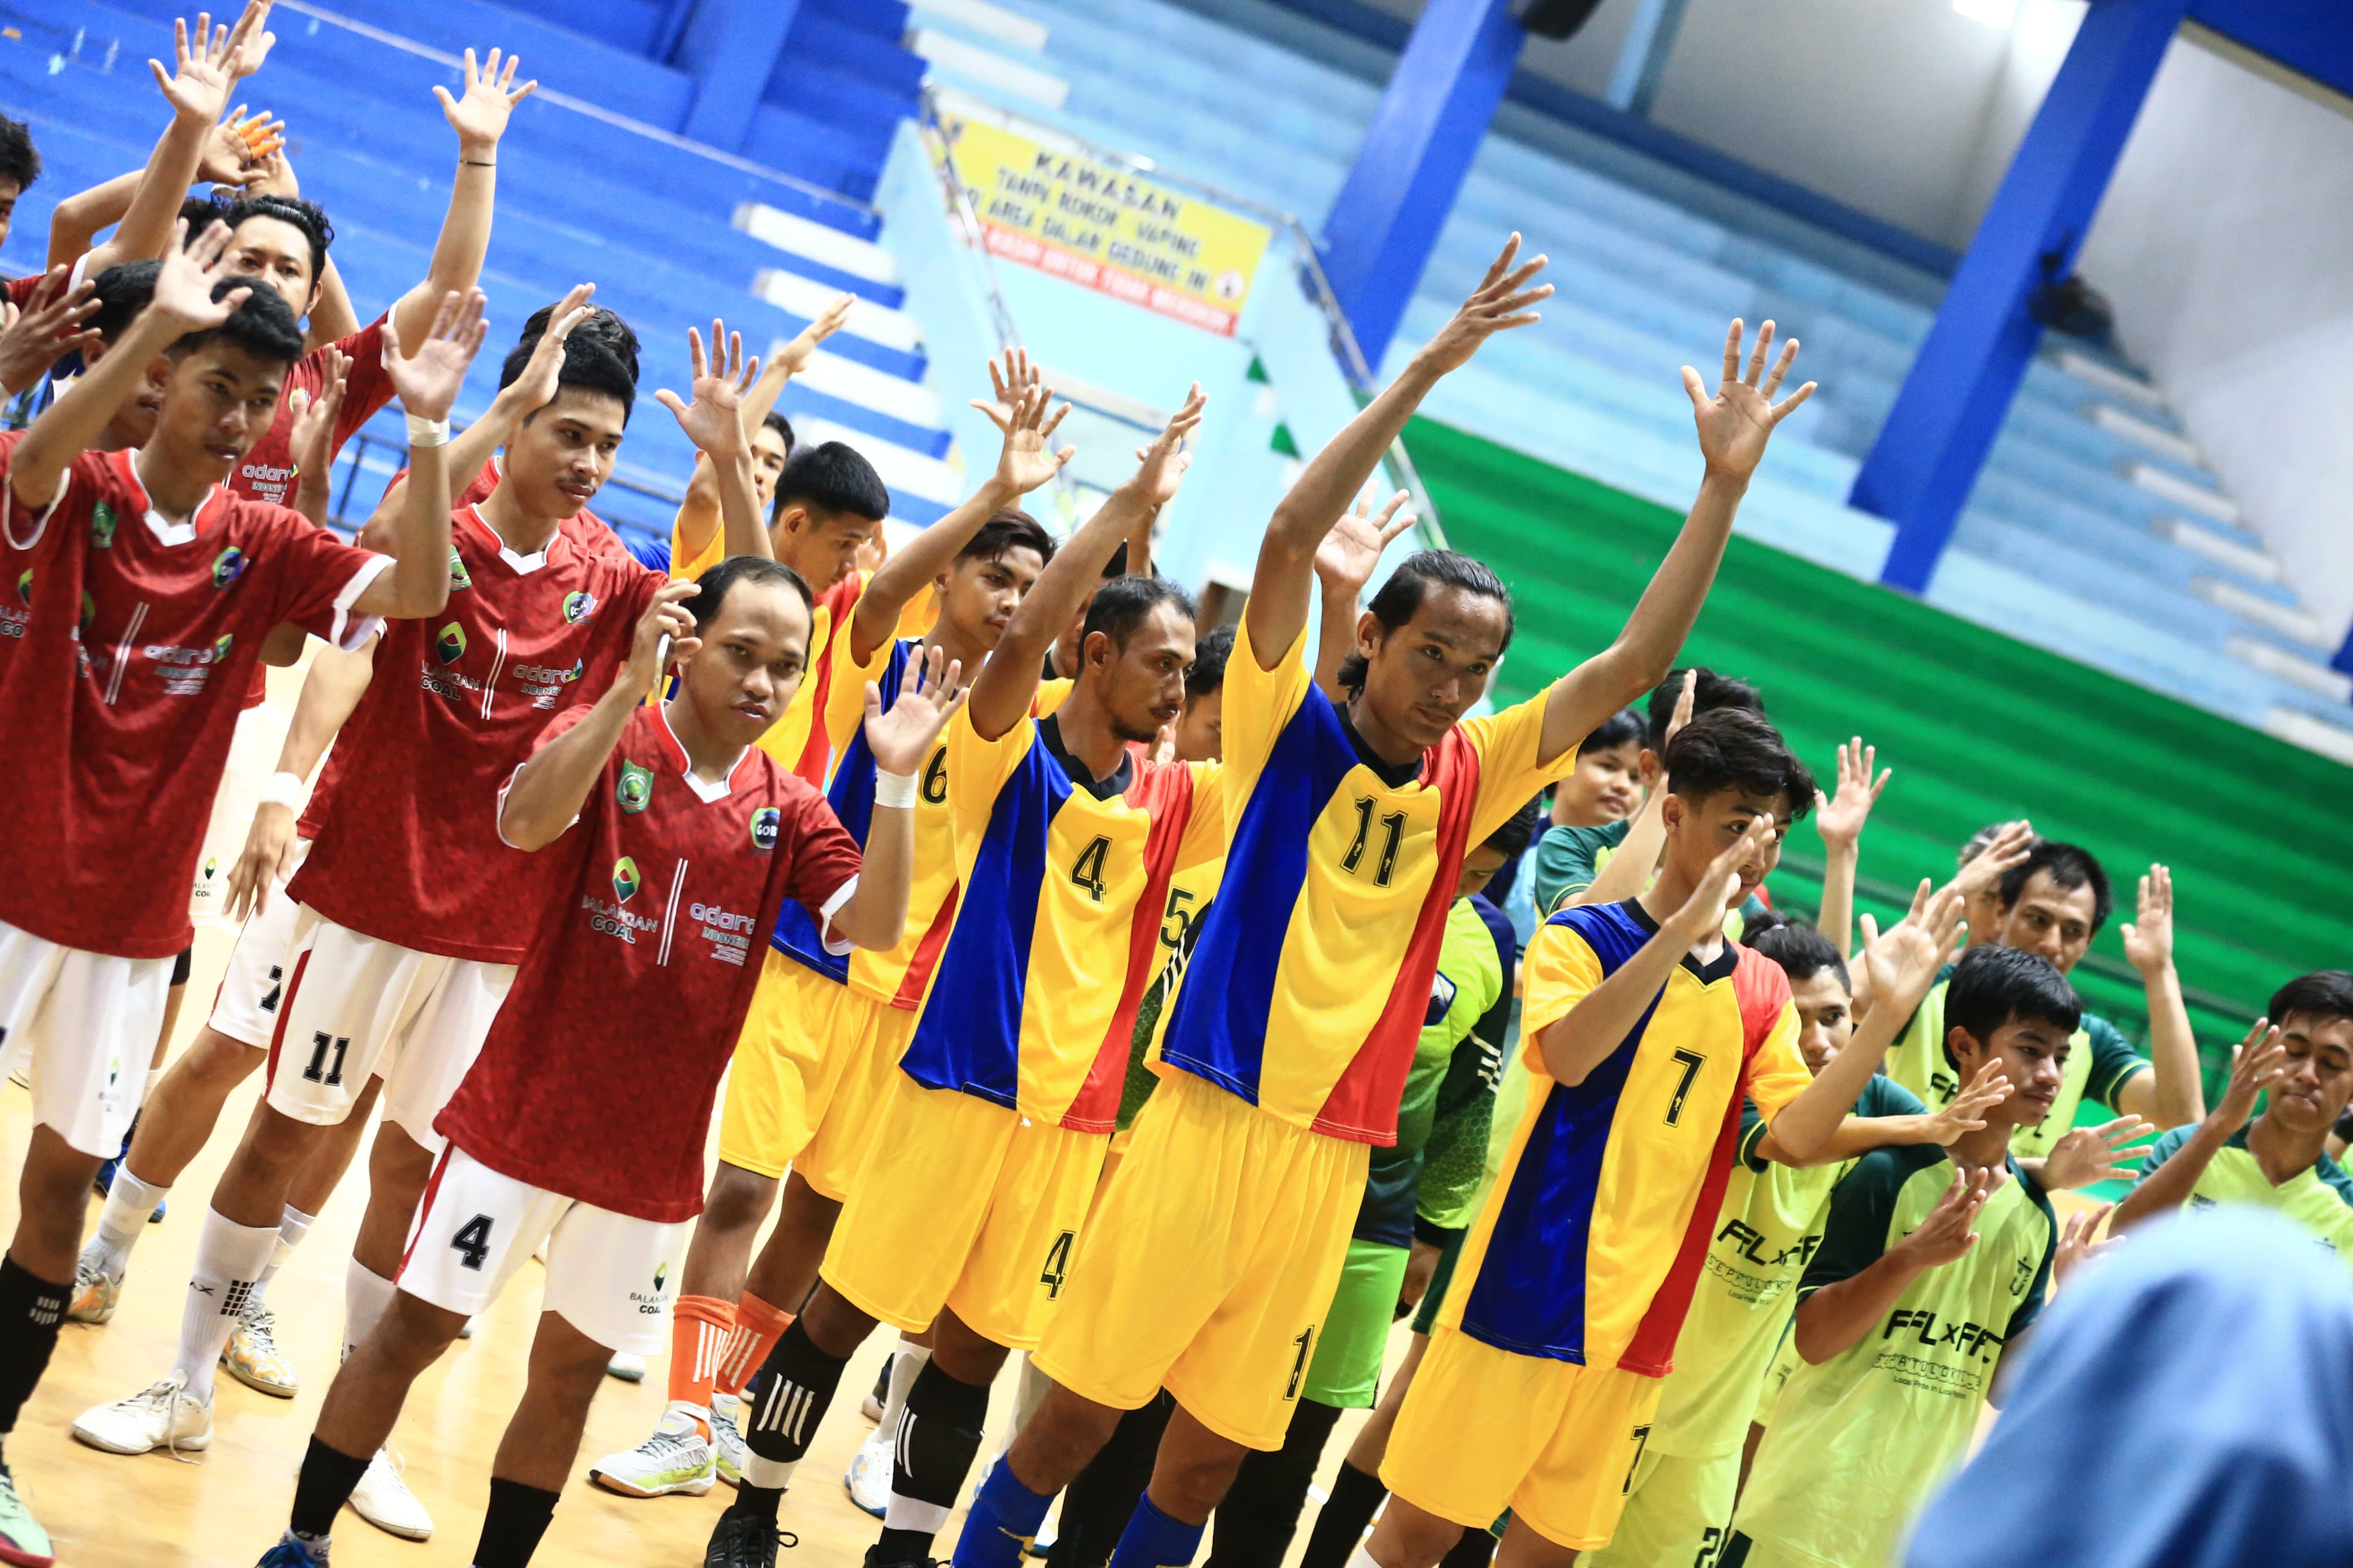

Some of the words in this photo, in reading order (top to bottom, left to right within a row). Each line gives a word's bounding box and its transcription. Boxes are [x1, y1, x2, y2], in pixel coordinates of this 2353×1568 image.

[1070, 834, 1113, 904] 4
[1339, 794, 1408, 888] 11
[591, 915, 636, 945] COAL
[303, 1030, 350, 1086] 11
[1663, 1046, 1707, 1128] 7
[450, 1213, 495, 1272] 4
[1040, 1229, 1076, 1301] 4
